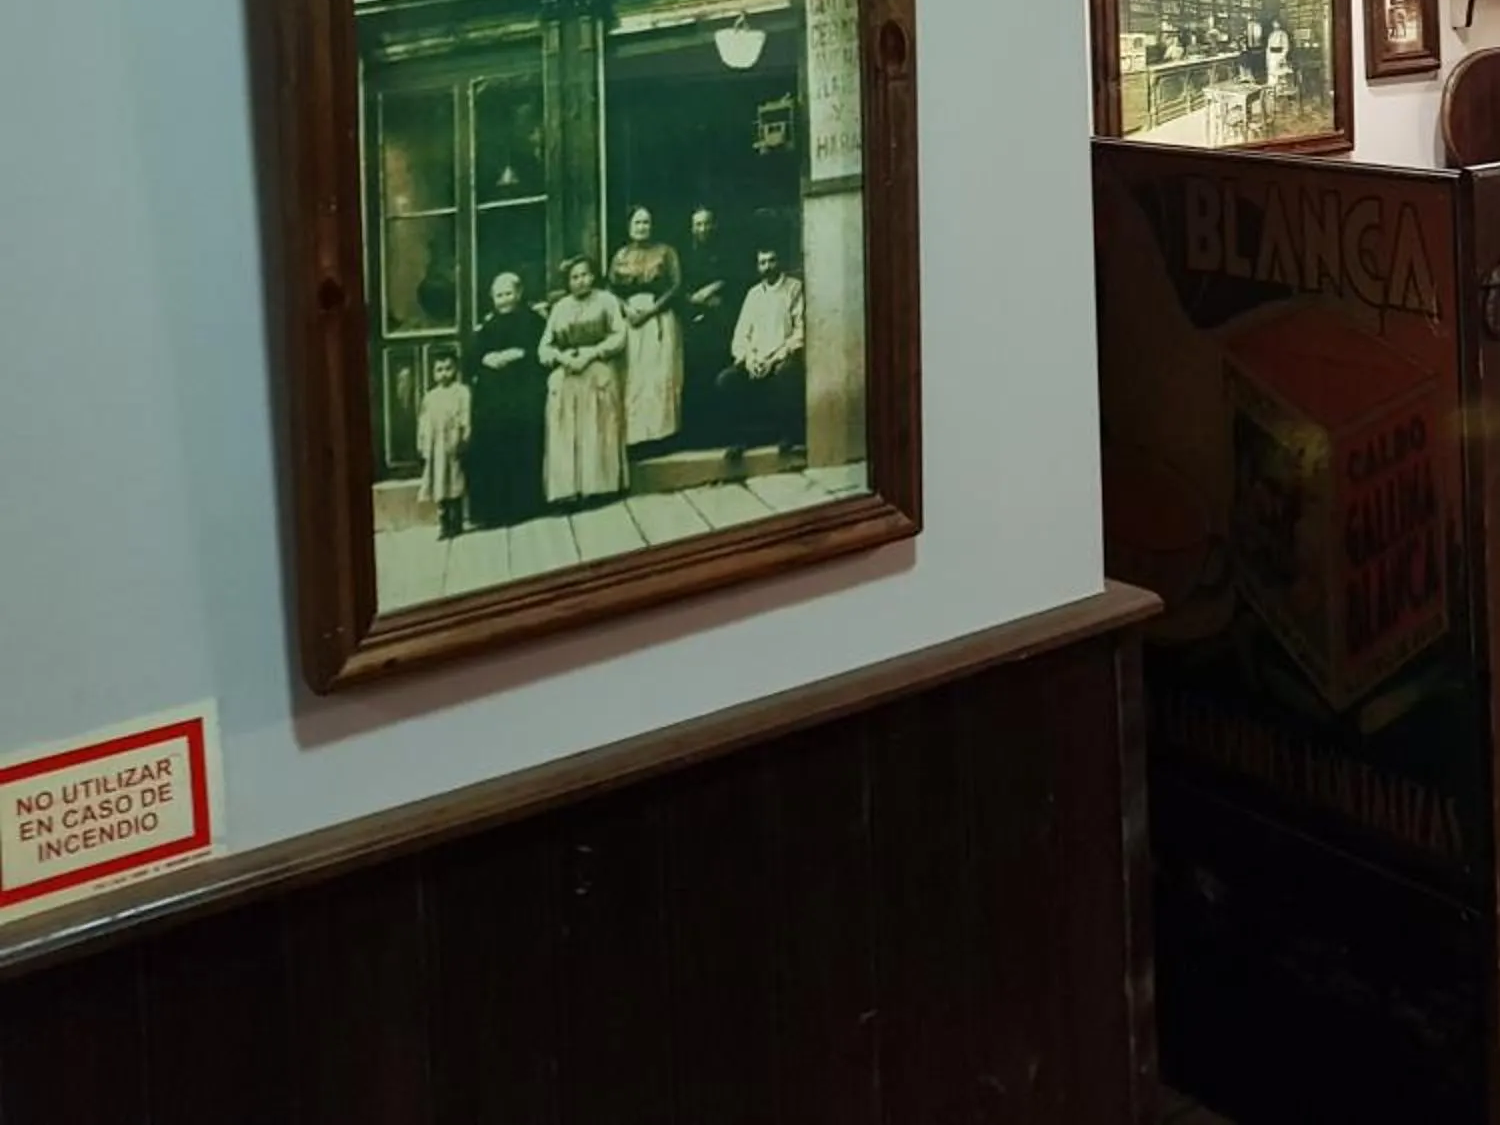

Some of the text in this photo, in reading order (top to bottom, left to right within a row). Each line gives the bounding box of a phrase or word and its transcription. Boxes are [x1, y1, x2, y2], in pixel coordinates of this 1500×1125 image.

[1184, 175, 1443, 323] BLANCA
[16, 758, 173, 817] NO UTILIZAR
[19, 782, 174, 842] EN CASO DE
[38, 811, 159, 863] INCENDIO
